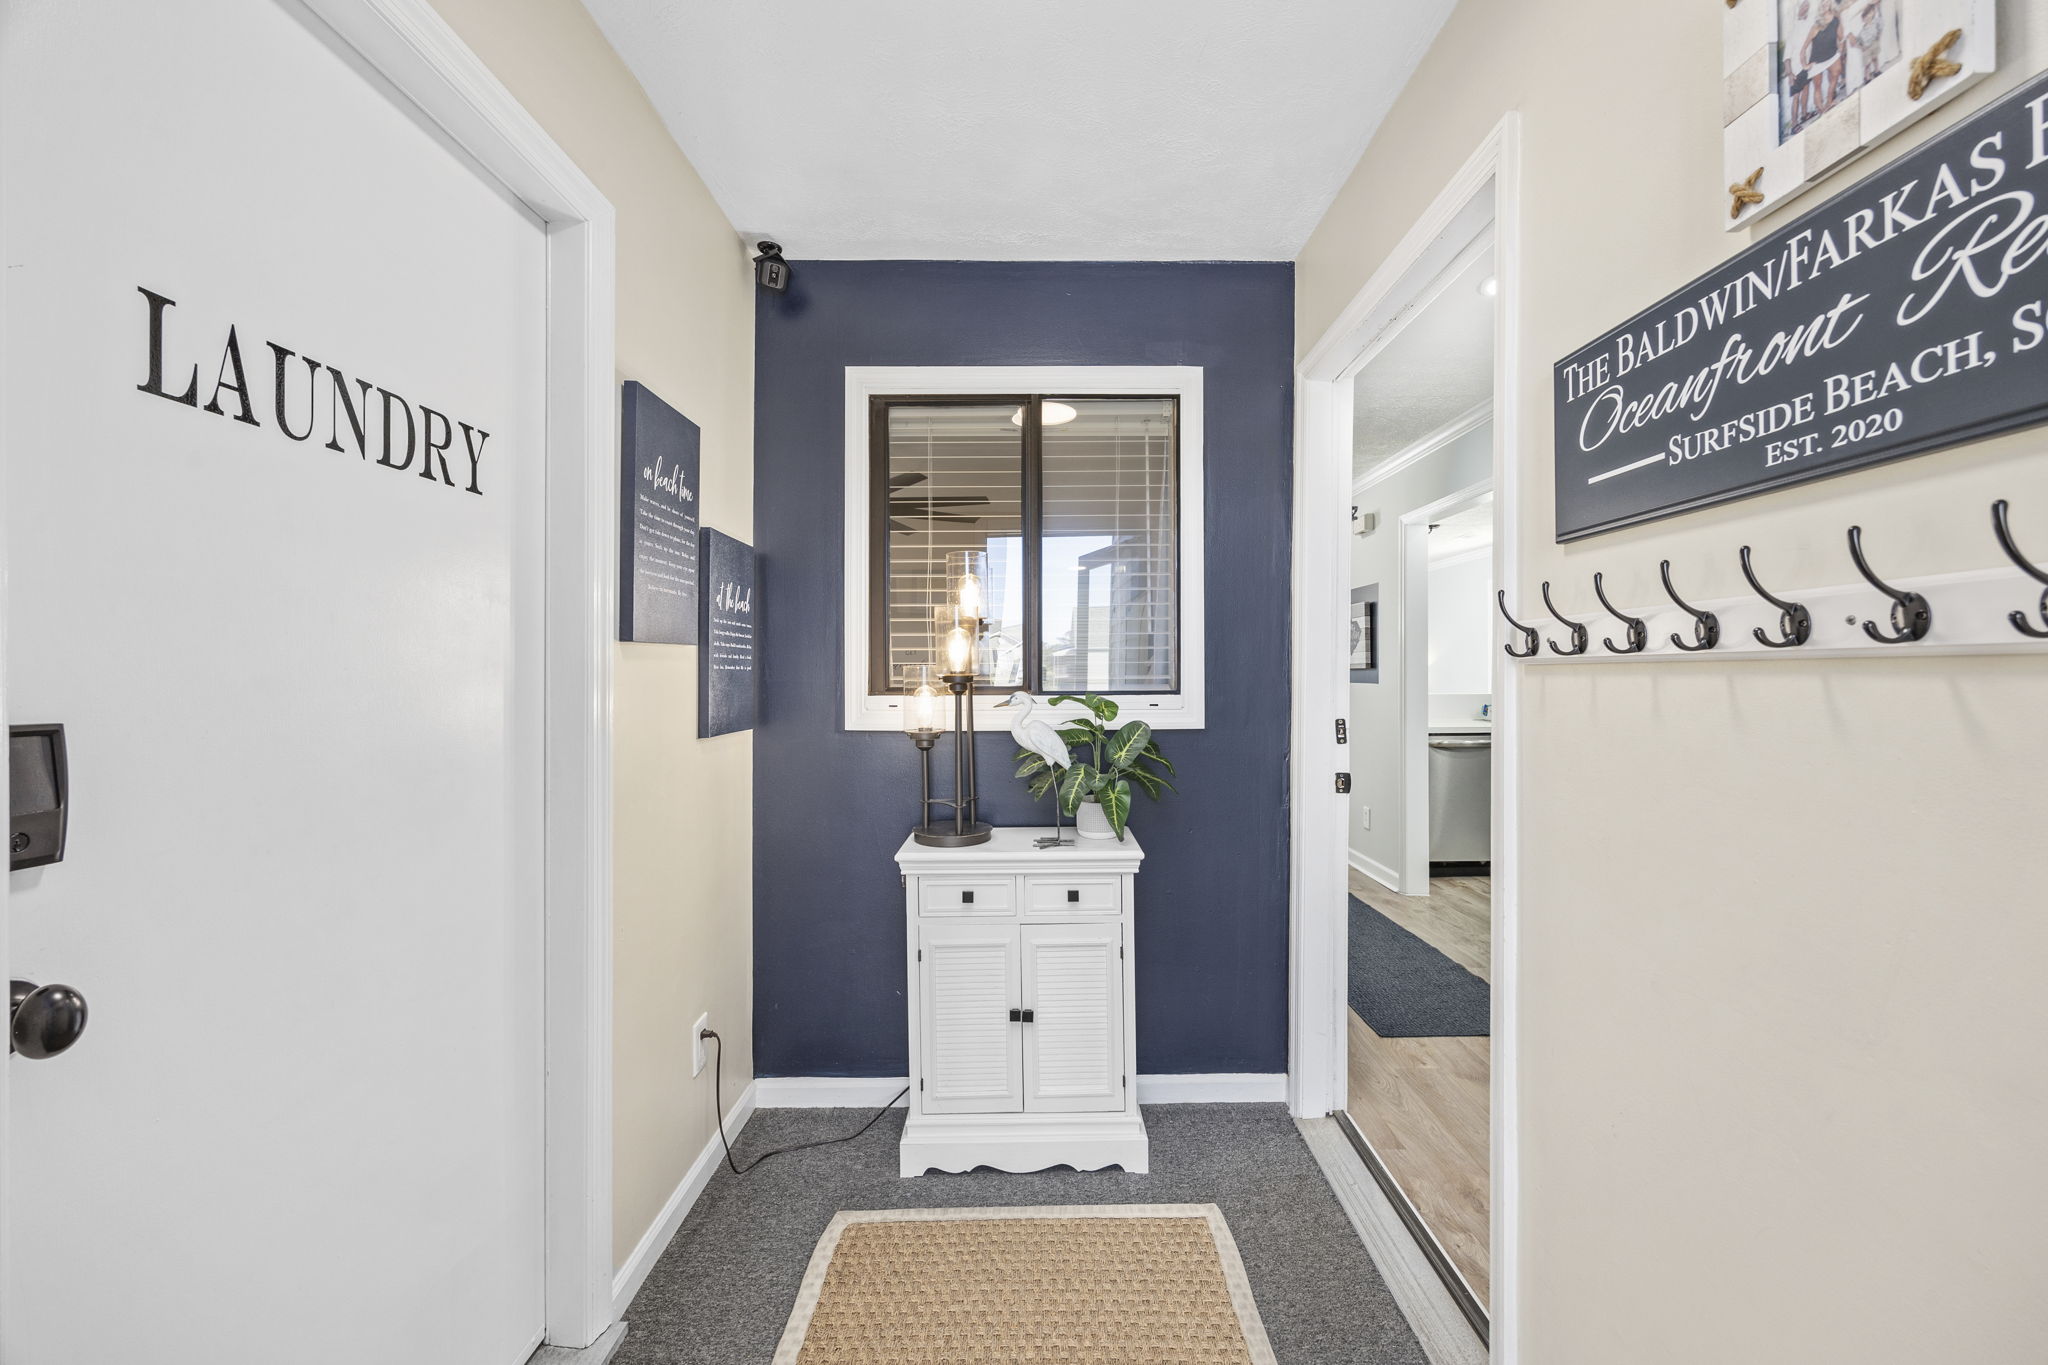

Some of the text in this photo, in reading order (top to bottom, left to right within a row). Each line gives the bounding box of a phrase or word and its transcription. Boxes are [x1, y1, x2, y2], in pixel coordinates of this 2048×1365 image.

[1616, 131, 2006, 378] BALDWIN/FARKAS
[136, 285, 490, 496] LAUNDRY
[1579, 293, 1871, 452] Oceanfront
[1668, 393, 1816, 466] SURFSIDE
[1824, 330, 1997, 416] BEACH,
[1765, 407, 1903, 468] EST. 2020
[653, 455, 680, 495] beach
